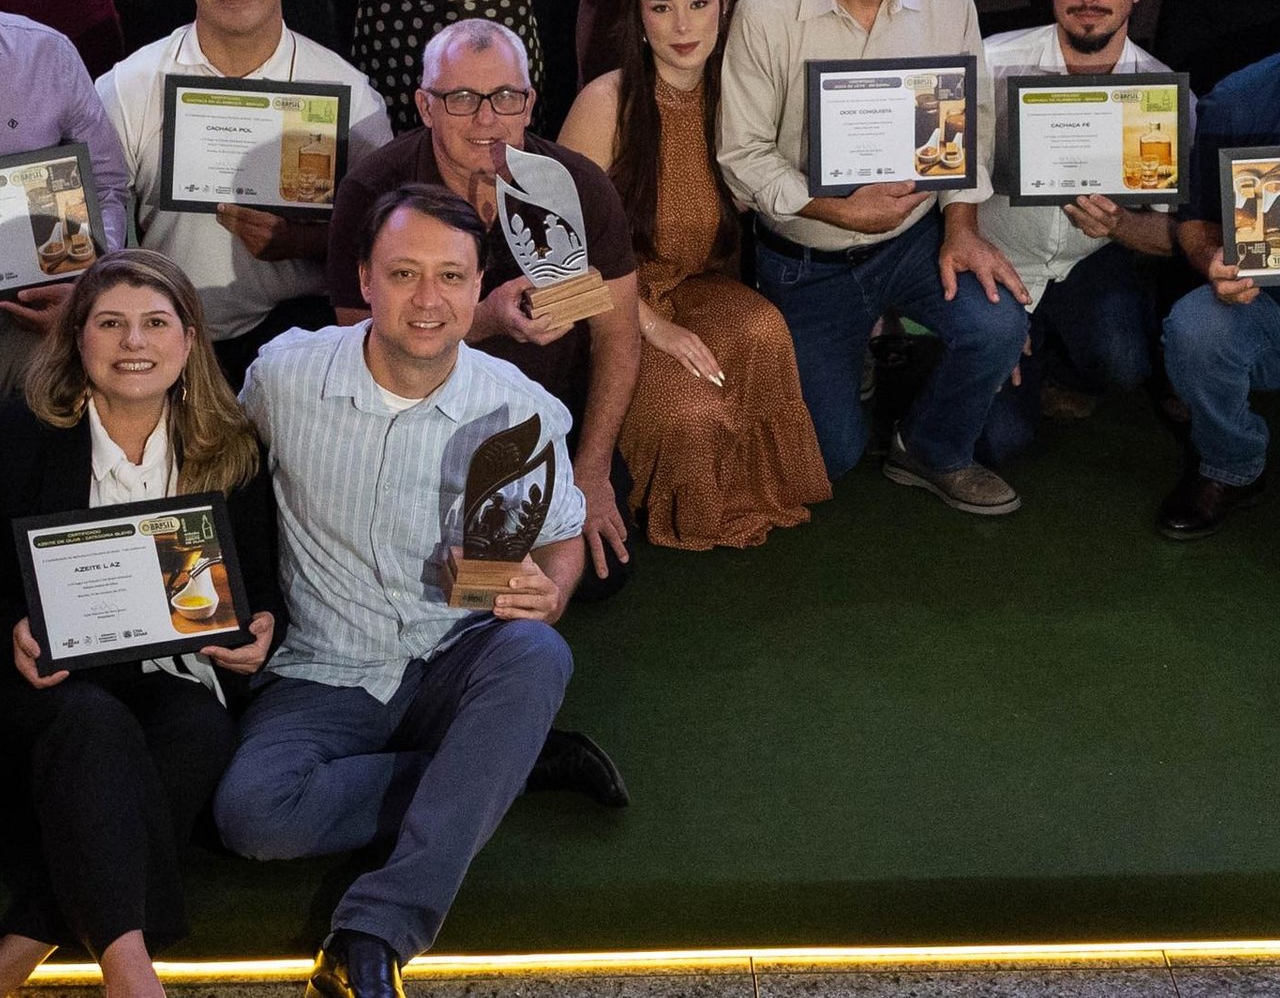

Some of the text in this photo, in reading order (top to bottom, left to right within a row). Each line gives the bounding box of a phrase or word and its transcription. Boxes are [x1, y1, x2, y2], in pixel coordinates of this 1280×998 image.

[206, 124, 237, 133] CACHAÇA
[149, 521, 175, 531] BRASIL
[67, 529, 102, 538] CERTIFICADO
[74, 564, 101, 573] AZEITE
